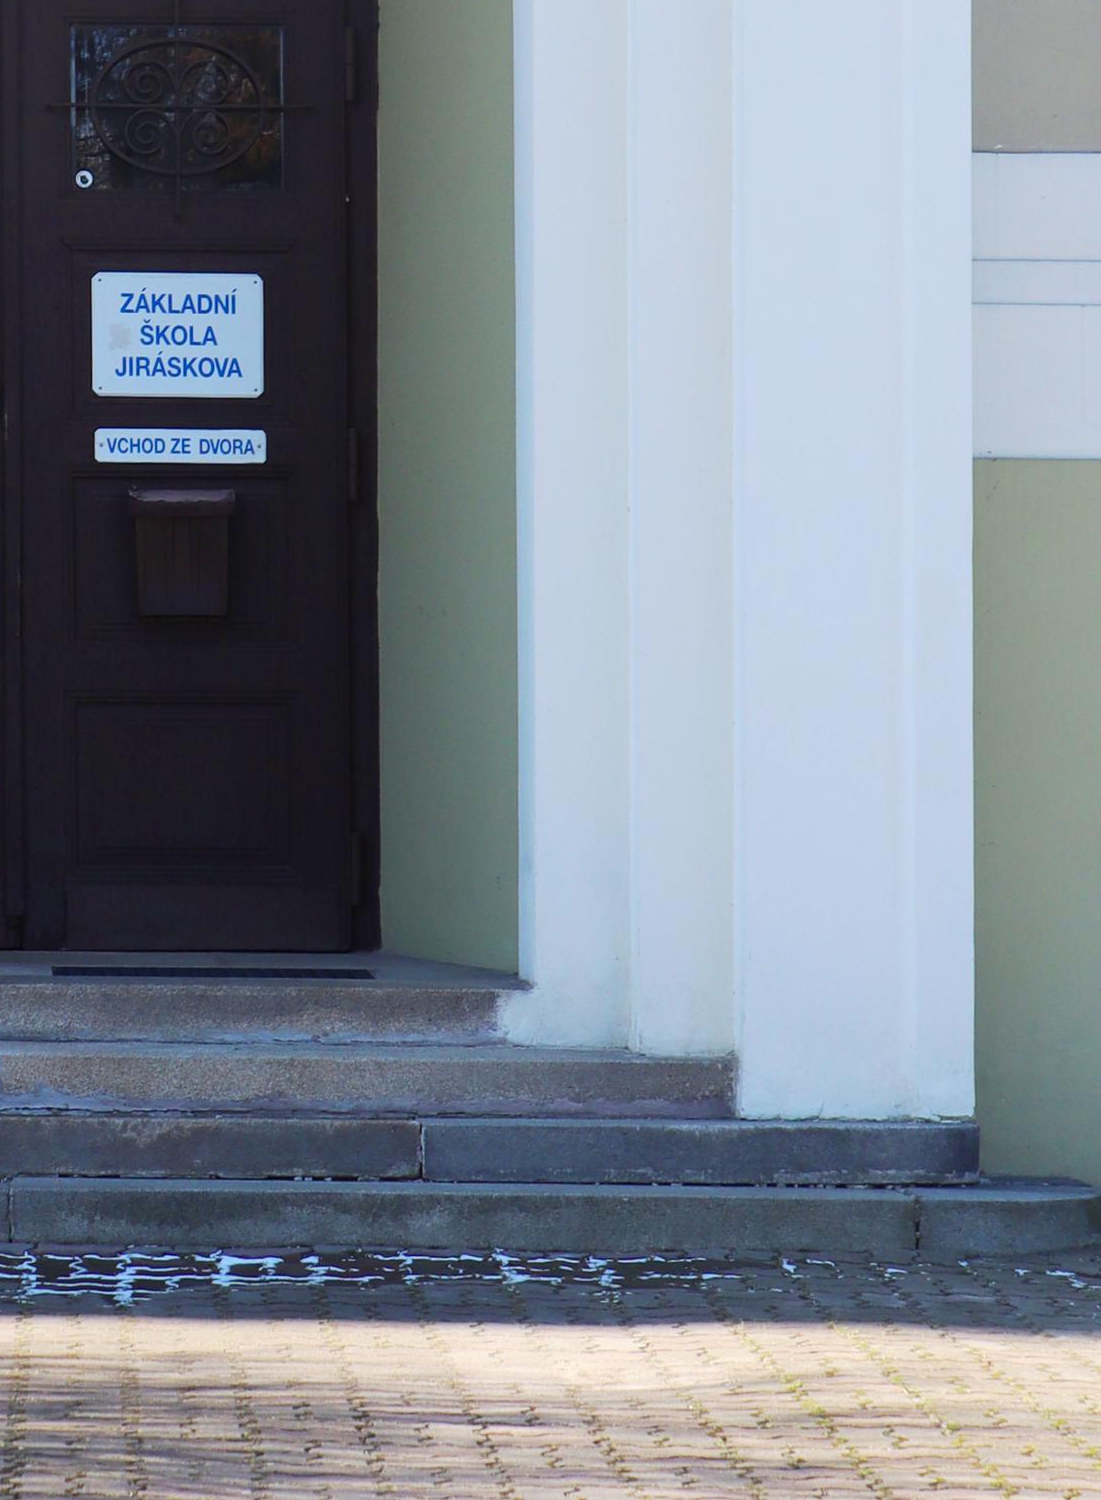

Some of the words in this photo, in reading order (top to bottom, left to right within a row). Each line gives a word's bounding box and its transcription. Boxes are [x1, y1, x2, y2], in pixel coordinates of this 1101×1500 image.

[120, 287, 237, 314] ZÁKLADNÍ
[140, 319, 218, 346] ŠKOLA
[115, 351, 243, 378] JIRÁSKOVA
[107, 437, 166, 454] VCHOD
[170, 438, 191, 454] ZE
[199, 438, 255, 455] DVORA
